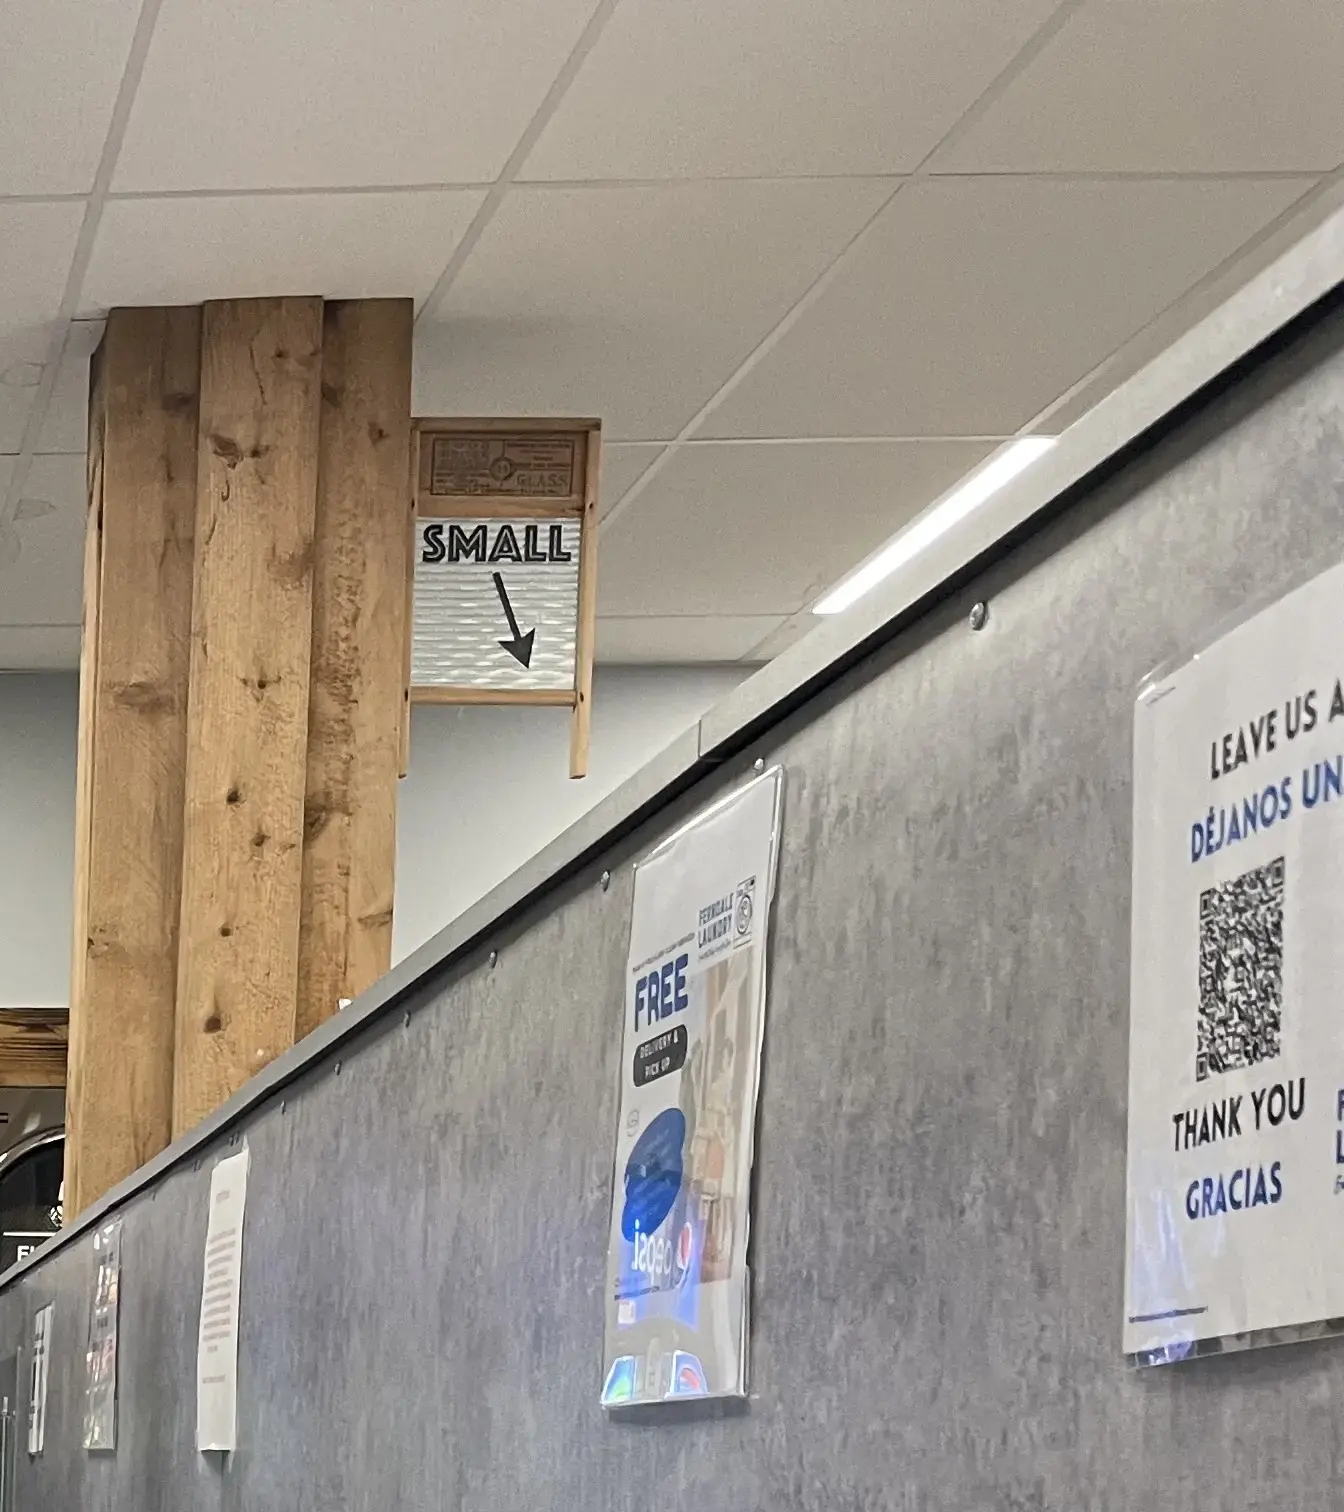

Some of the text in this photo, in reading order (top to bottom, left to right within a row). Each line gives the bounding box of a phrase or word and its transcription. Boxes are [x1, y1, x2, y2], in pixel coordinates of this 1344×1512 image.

[422, 524, 572, 563] SMALL
[1210, 708, 1278, 781] LEAVE
[1285, 689, 1318, 740] US
[1190, 776, 1293, 864] DÉJANOS
[697, 913, 733, 949] LAUNDRY
[634, 953, 689, 1033] FREE
[1172, 1095, 1243, 1152] THANK
[1250, 1077, 1306, 1131] YOU
[1185, 1161, 1283, 1221] GRACIAS
